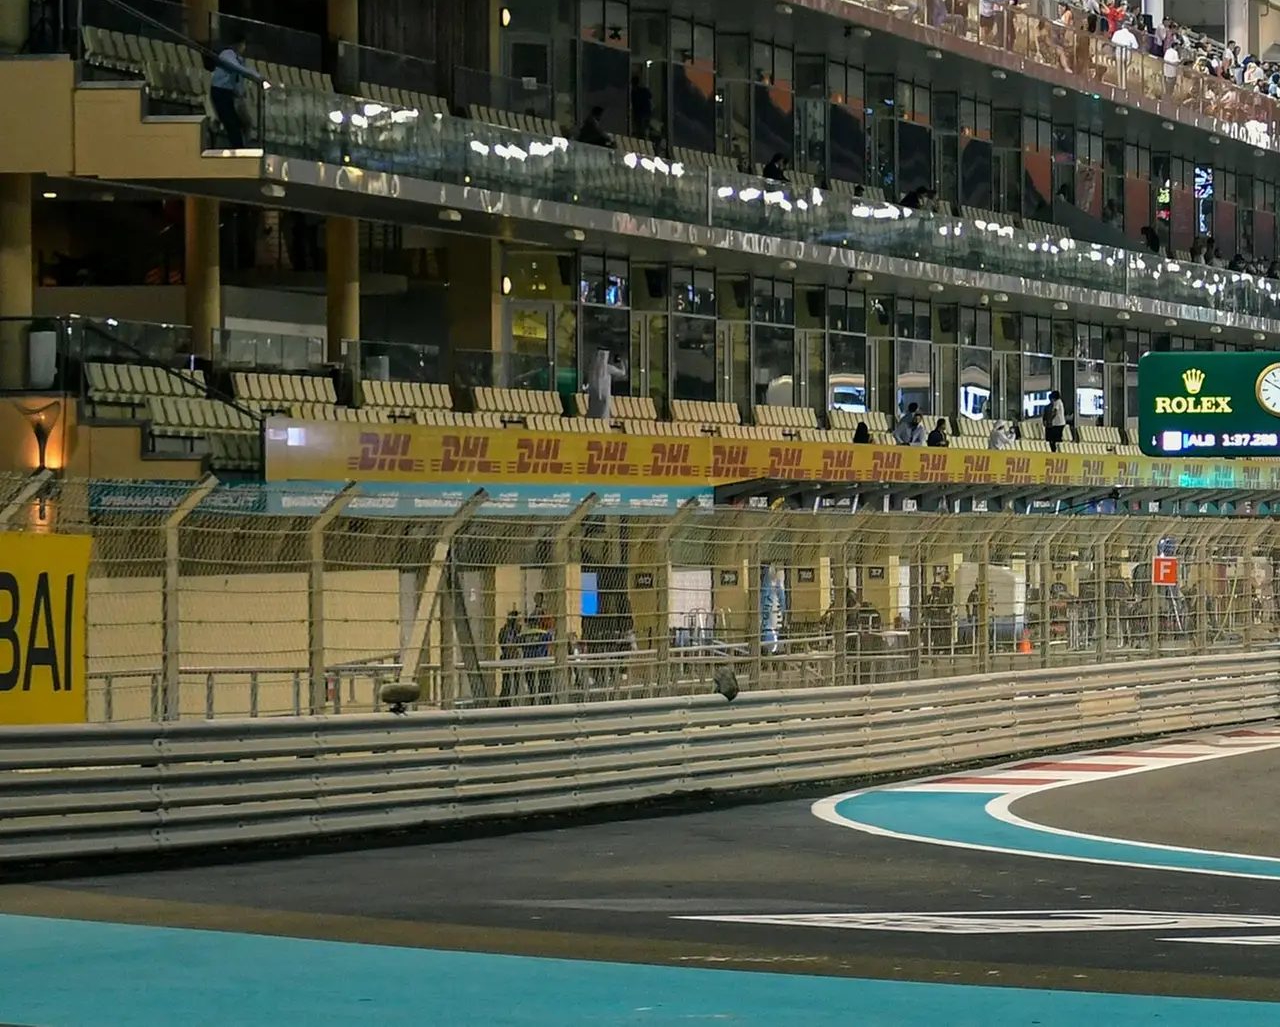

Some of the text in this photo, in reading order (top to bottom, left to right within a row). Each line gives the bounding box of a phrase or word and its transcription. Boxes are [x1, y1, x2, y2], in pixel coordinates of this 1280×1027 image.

[1155, 396, 1233, 414] ROLEX
[1189, 434, 1215, 447] ALB
[359, 432, 414, 472] DHL
[442, 435, 493, 473] DHL
[516, 437, 564, 474] DHL
[586, 440, 631, 475] DHL
[651, 442, 692, 476] DHL
[712, 445, 750, 478] DHL
[769, 447, 805, 478] DHL
[822, 449, 858, 481] DHL
[872, 451, 907, 482] DHL
[919, 453, 951, 483] DHL
[963, 455, 992, 483] DHL
[1005, 457, 1032, 484] DHL
[1045, 459, 1069, 484] DHL
[1160, 562, 1171, 581] F
